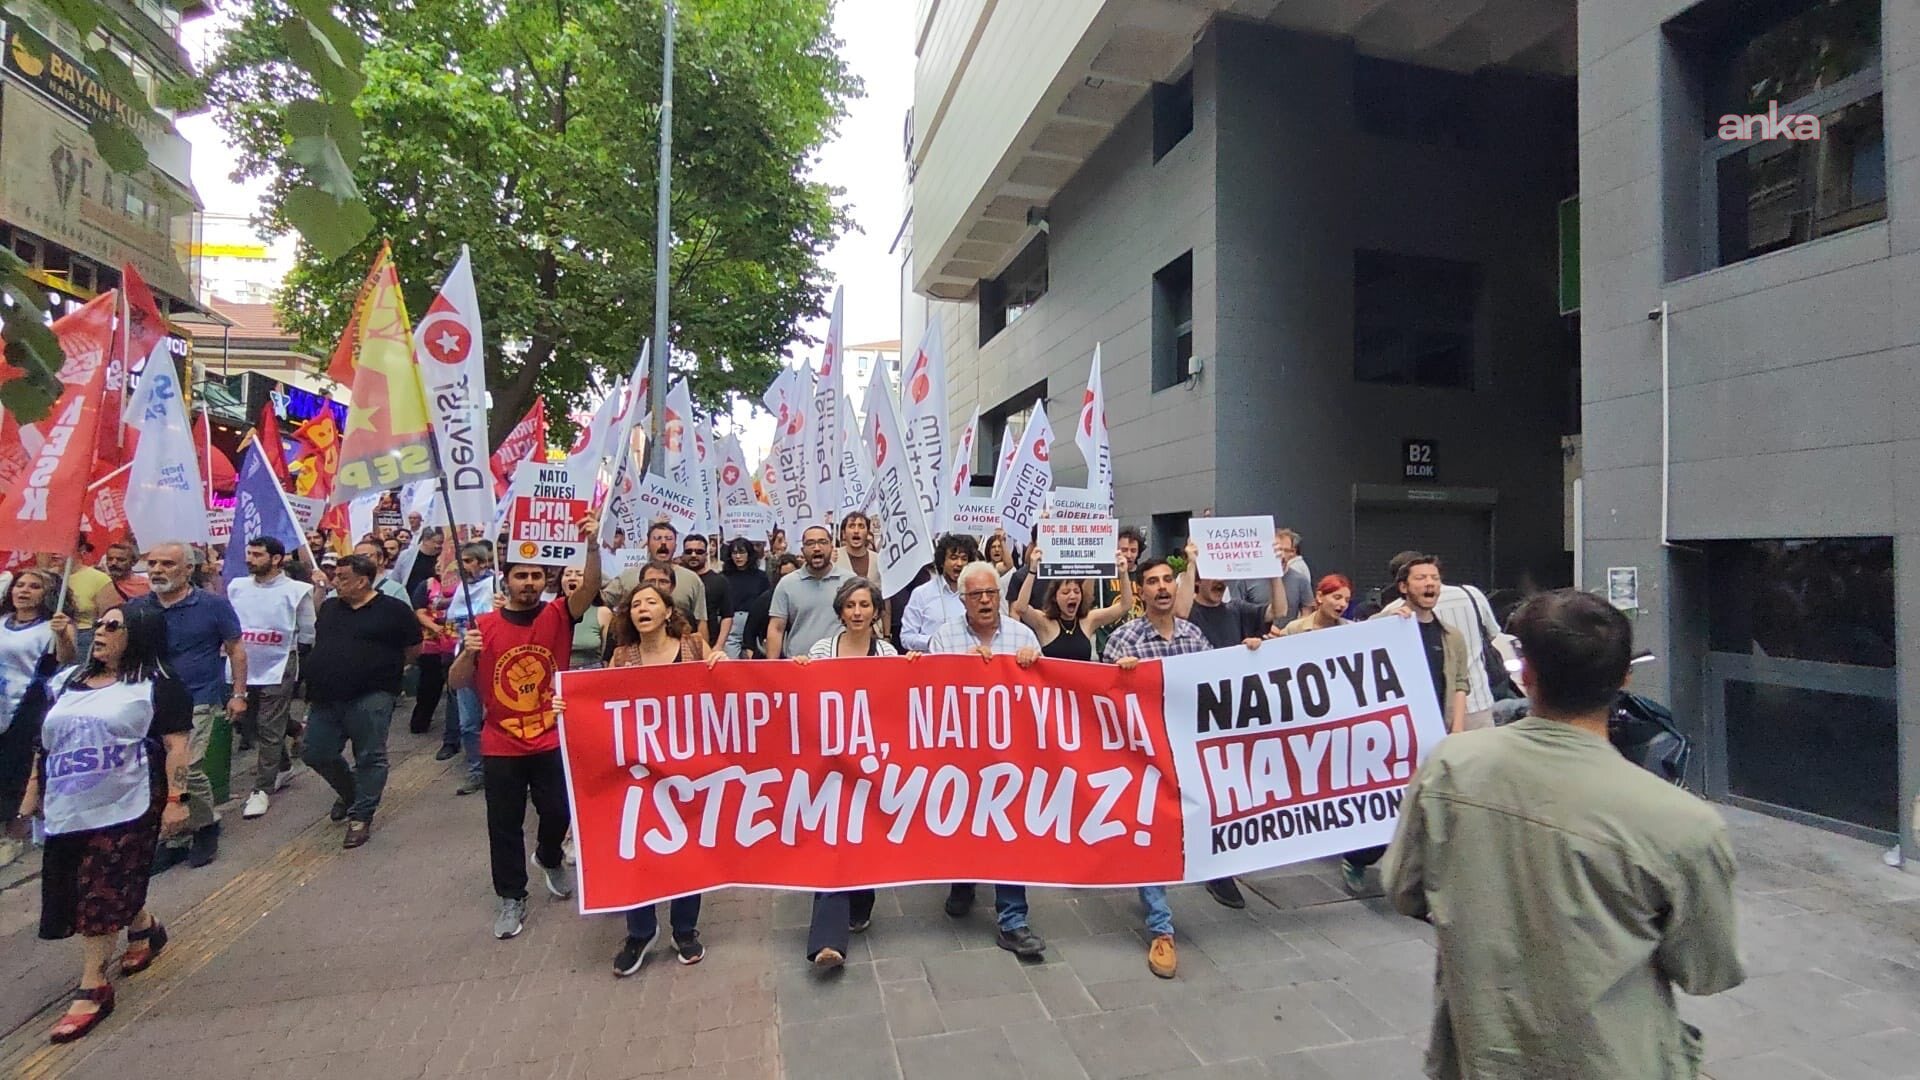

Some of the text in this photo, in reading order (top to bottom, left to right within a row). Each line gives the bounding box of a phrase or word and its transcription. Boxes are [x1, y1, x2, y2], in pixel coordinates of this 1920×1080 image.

[48, 79, 75, 103] HAIR
[50, 53, 111, 112] BAYAN
[1409, 444, 1431, 462] B2
[540, 469, 568, 484] NATO
[1406, 464, 1434, 476] BLOK
[533, 483, 576, 499] ZİRVESİ
[650, 483, 695, 508] YANKEE
[1002, 462, 1034, 520] Devrim
[1016, 468, 1048, 528] Partisi
[529, 498, 573, 521] İPTAL
[641, 493, 697, 521] GO HOME
[958, 504, 995, 514] YANKEE
[972, 515, 1000, 523] HOME
[1071, 525, 1088, 533] EMEL
[520, 519, 579, 542] EDİLSİN
[1206, 528, 1258, 541] YAŞASIN
[1051, 537, 1104, 546] DERHAL SERBEST
[541, 545, 576, 559] SEP
[241, 630, 283, 643] mob
[518, 682, 536, 695] SEP
[1197, 648, 1405, 734] NATO'YA
[604, 684, 1156, 767] TRUMP'I DA, NATO'YU DA
[1202, 713, 1411, 819] HAYIR!
[618, 755, 1161, 860] İSTEMİYORUZ!
